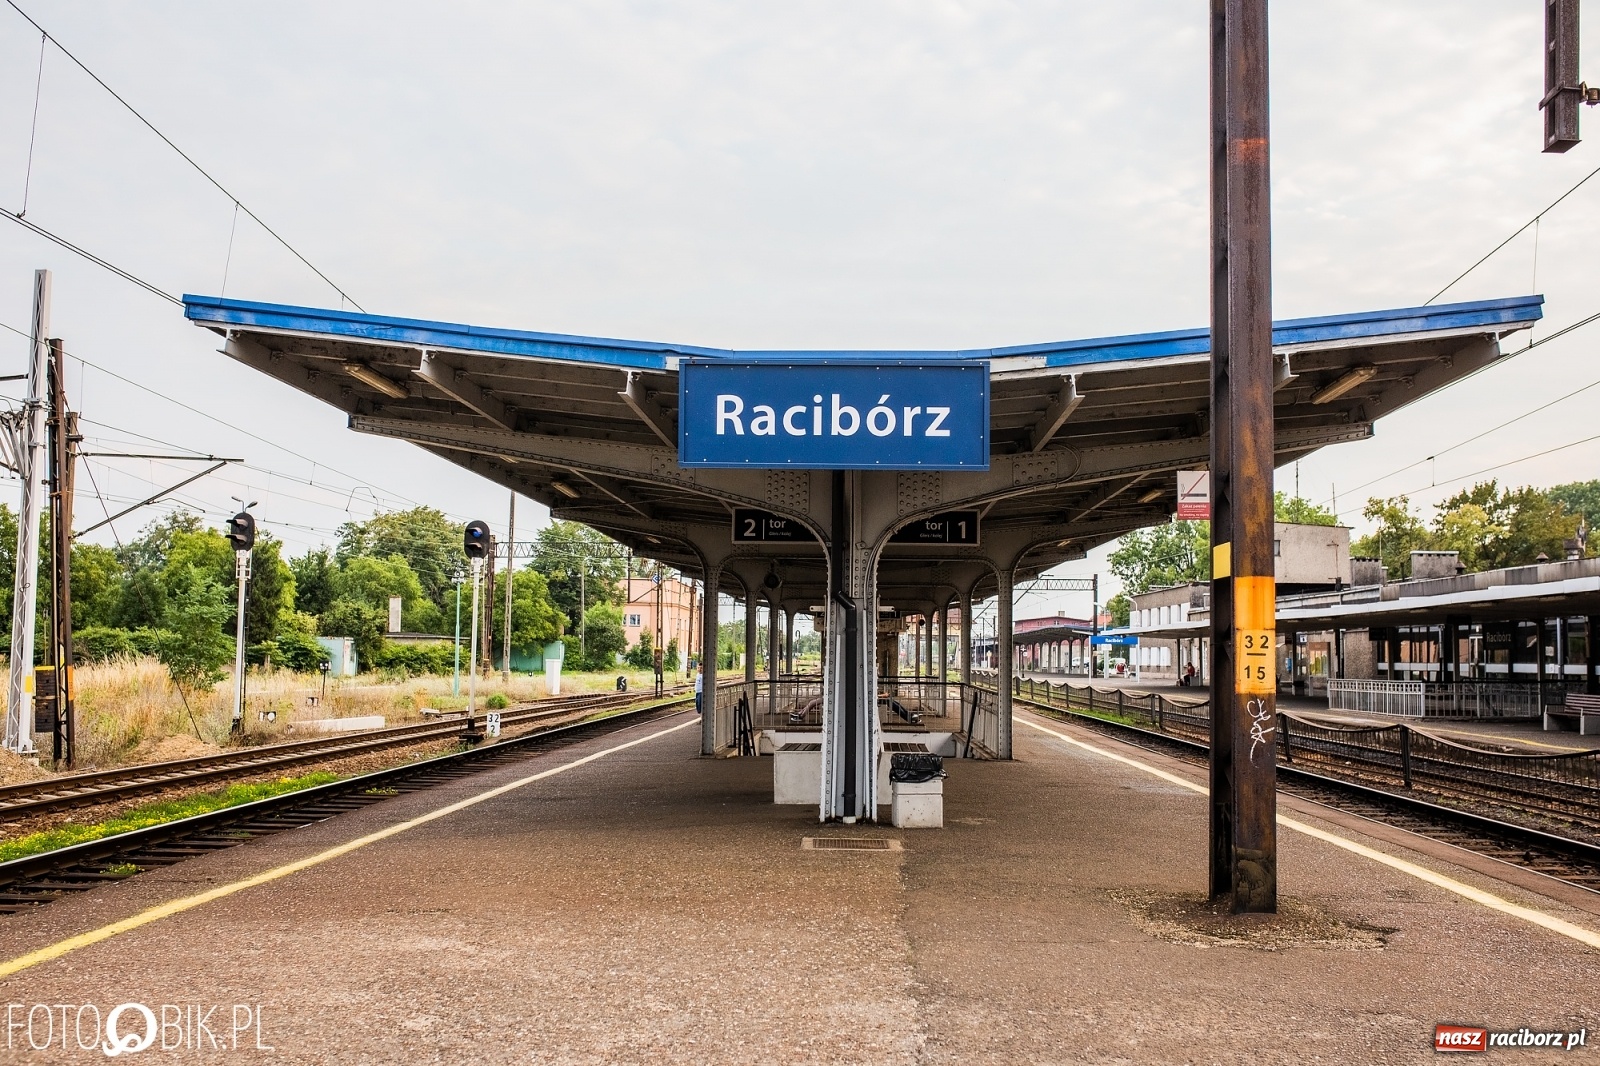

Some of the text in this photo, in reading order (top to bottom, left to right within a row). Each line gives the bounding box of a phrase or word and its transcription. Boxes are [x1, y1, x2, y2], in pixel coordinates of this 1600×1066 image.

[715, 393, 951, 437] Racibórz
[743, 518, 786, 537] 2 tor
[925, 520, 966, 539] tor 1
[490, 725, 496, 733] 2
